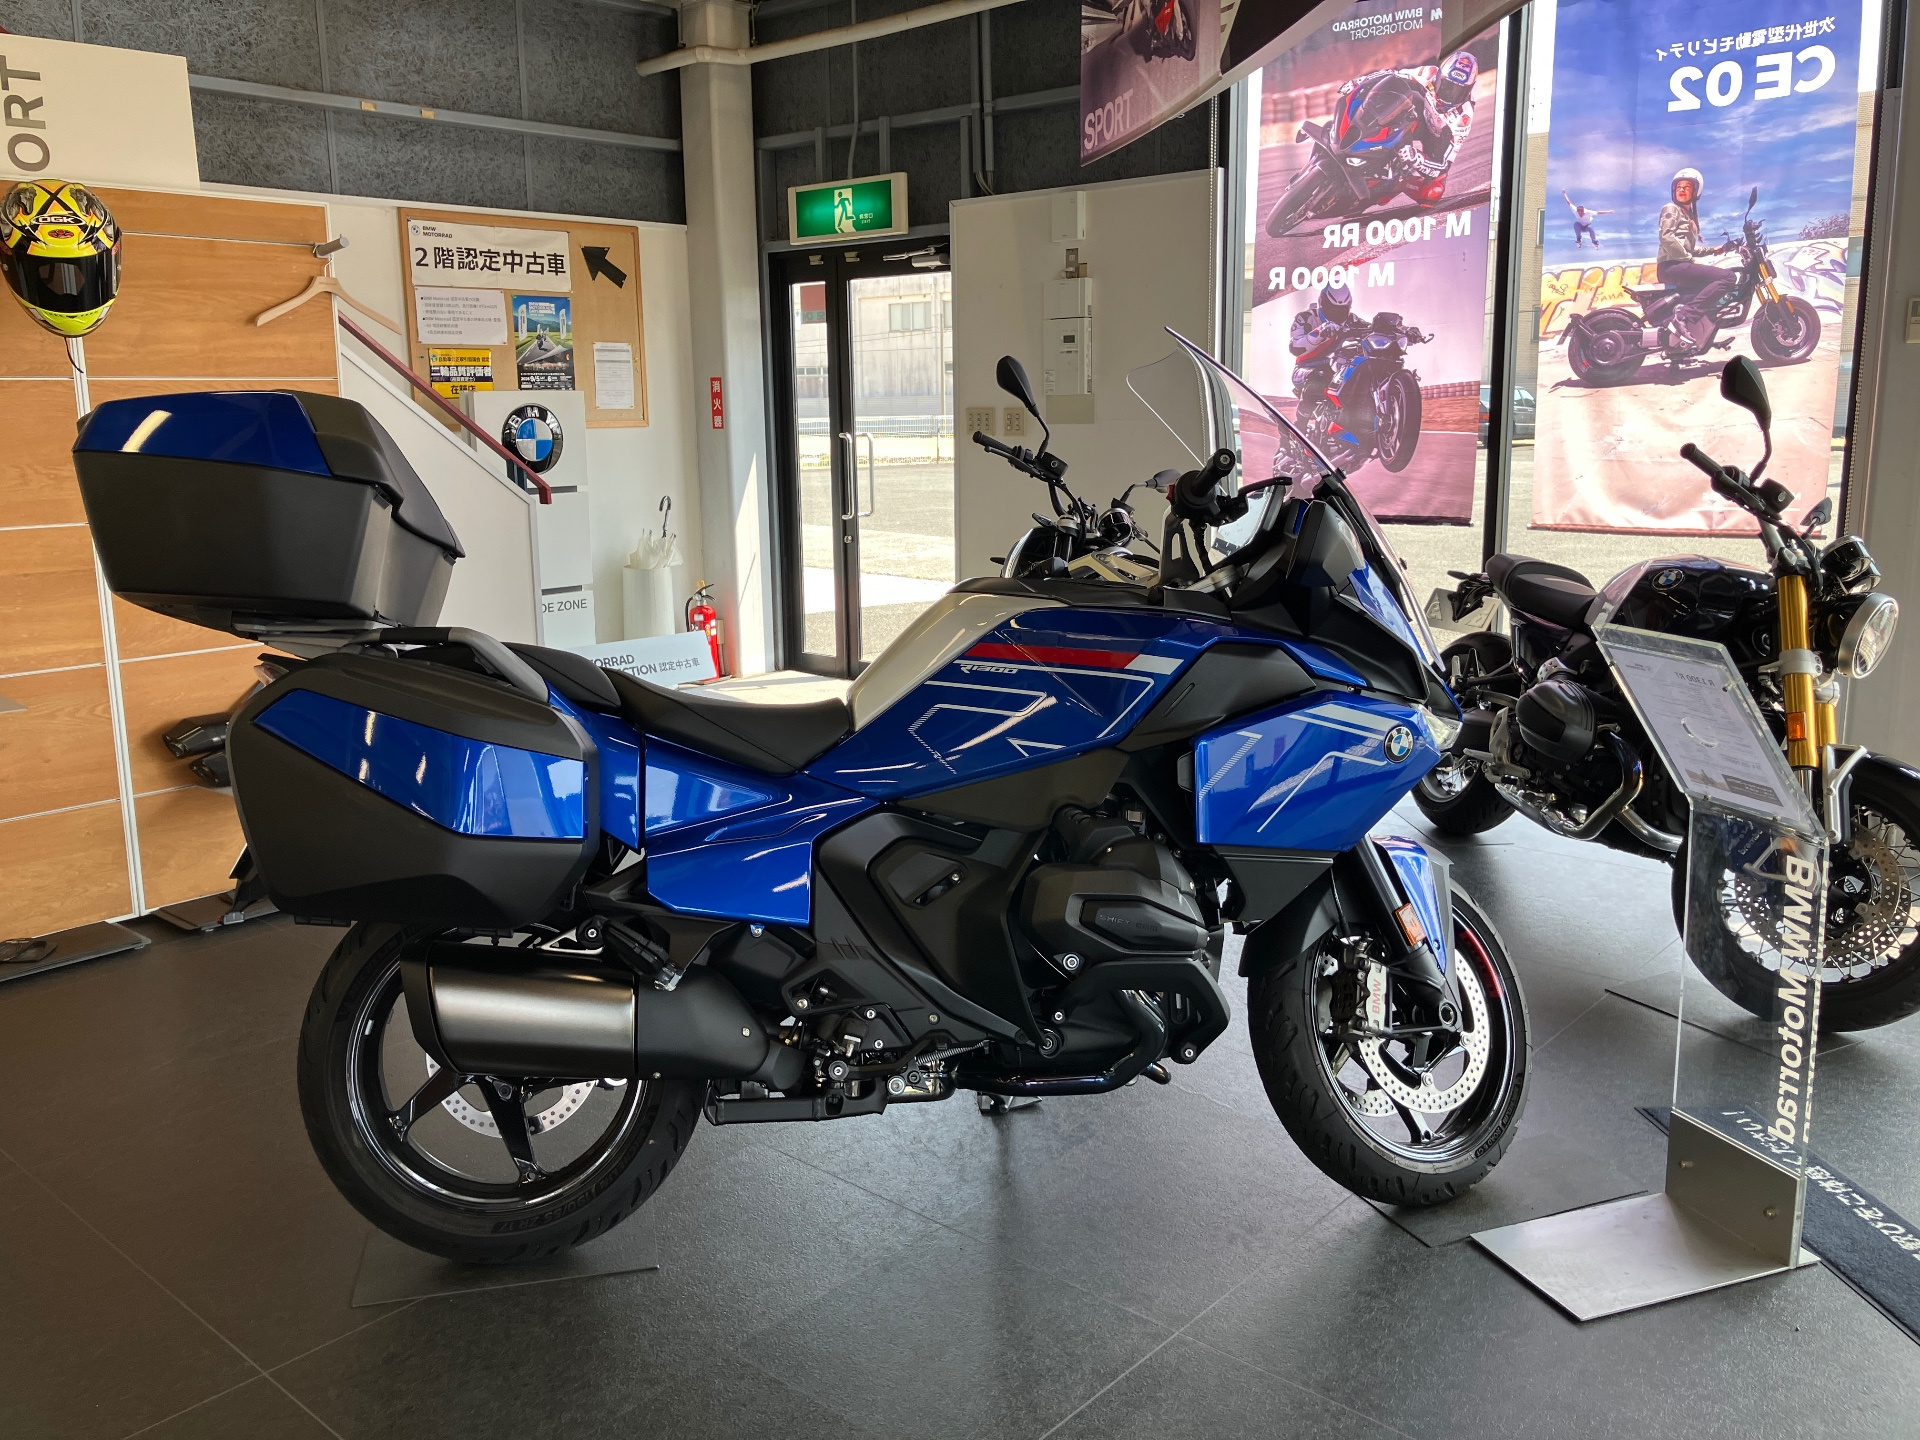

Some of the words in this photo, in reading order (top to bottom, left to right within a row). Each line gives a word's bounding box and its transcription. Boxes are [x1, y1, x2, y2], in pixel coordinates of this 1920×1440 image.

[1083, 88, 1135, 150] SPORT
[38, 216, 74, 225] OGK
[422, 231, 453, 239] MOTORRAD
[414, 245, 566, 276] 2階認定中古車
[711, 380, 723, 428] 消火器
[556, 598, 588, 612] ZONE
[620, 663, 657, 677] CTION
[658, 657, 701, 672] 認定中古車
[1371, 978, 1382, 1015] BMW
